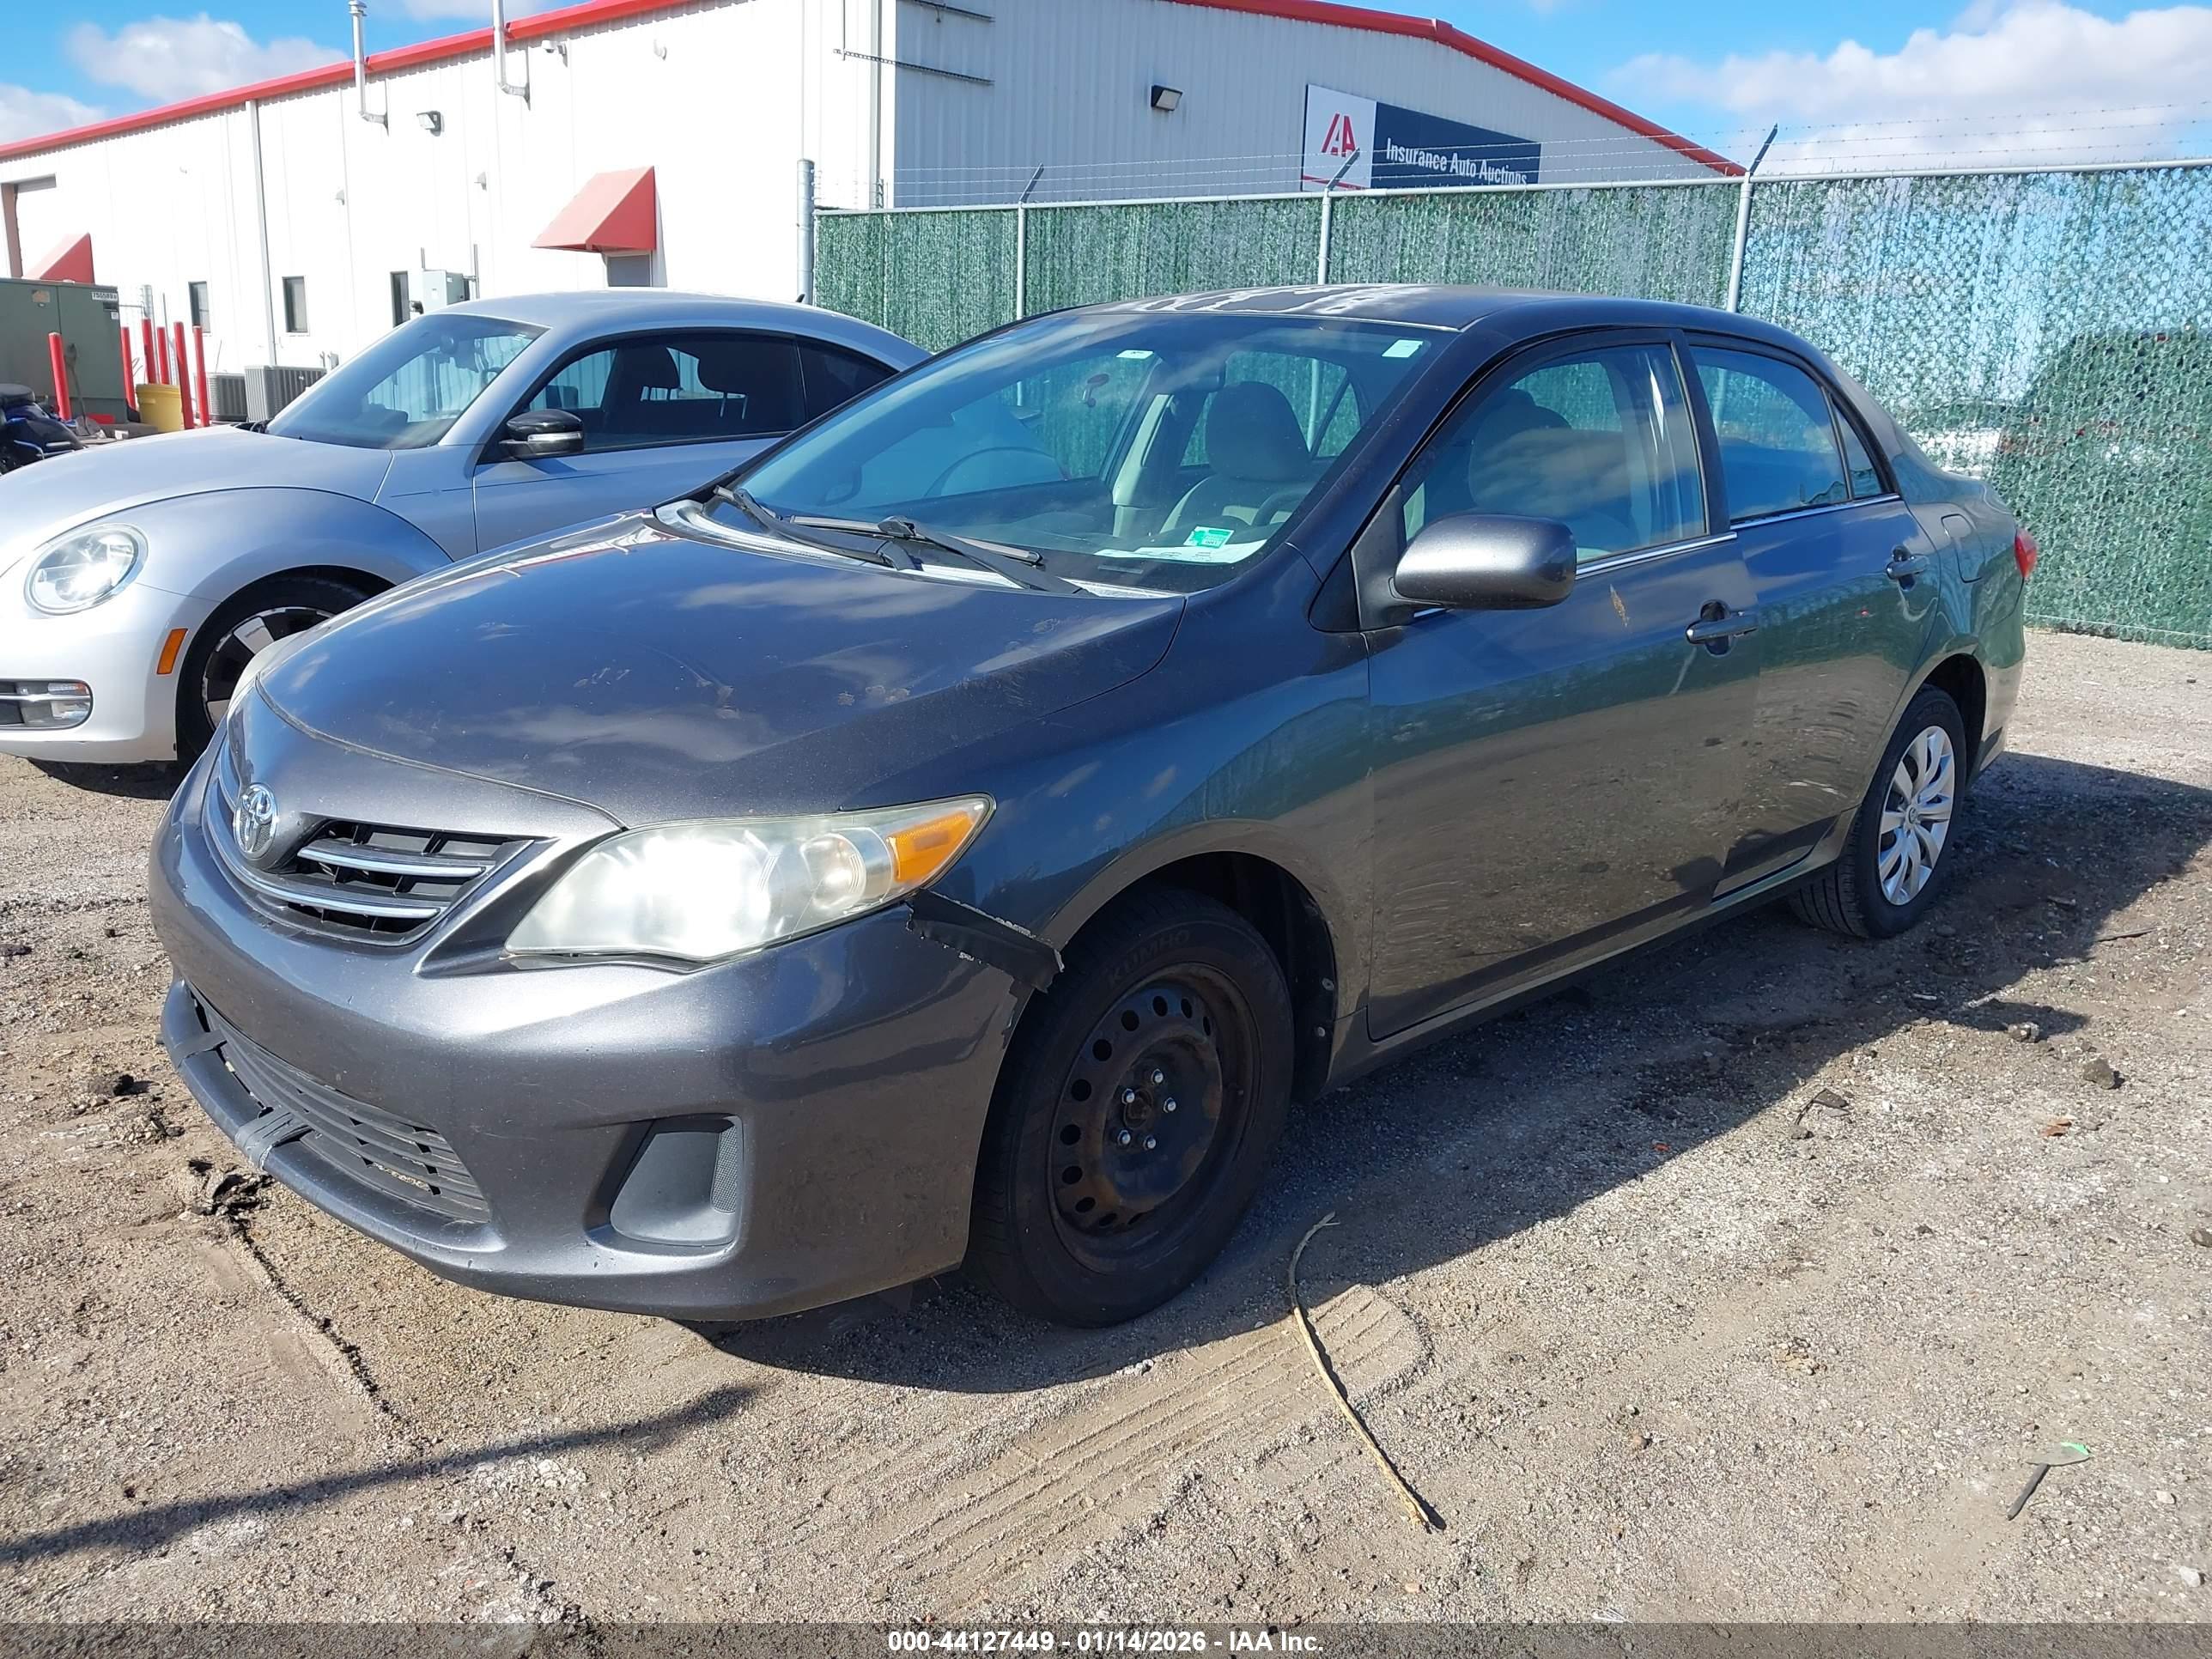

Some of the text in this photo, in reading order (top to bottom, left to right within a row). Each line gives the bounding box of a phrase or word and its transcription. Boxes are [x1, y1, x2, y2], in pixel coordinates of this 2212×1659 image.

[1386, 137, 1528, 186] Insurance Auto Auctions
[1106, 929, 1191, 989] KUMHO
